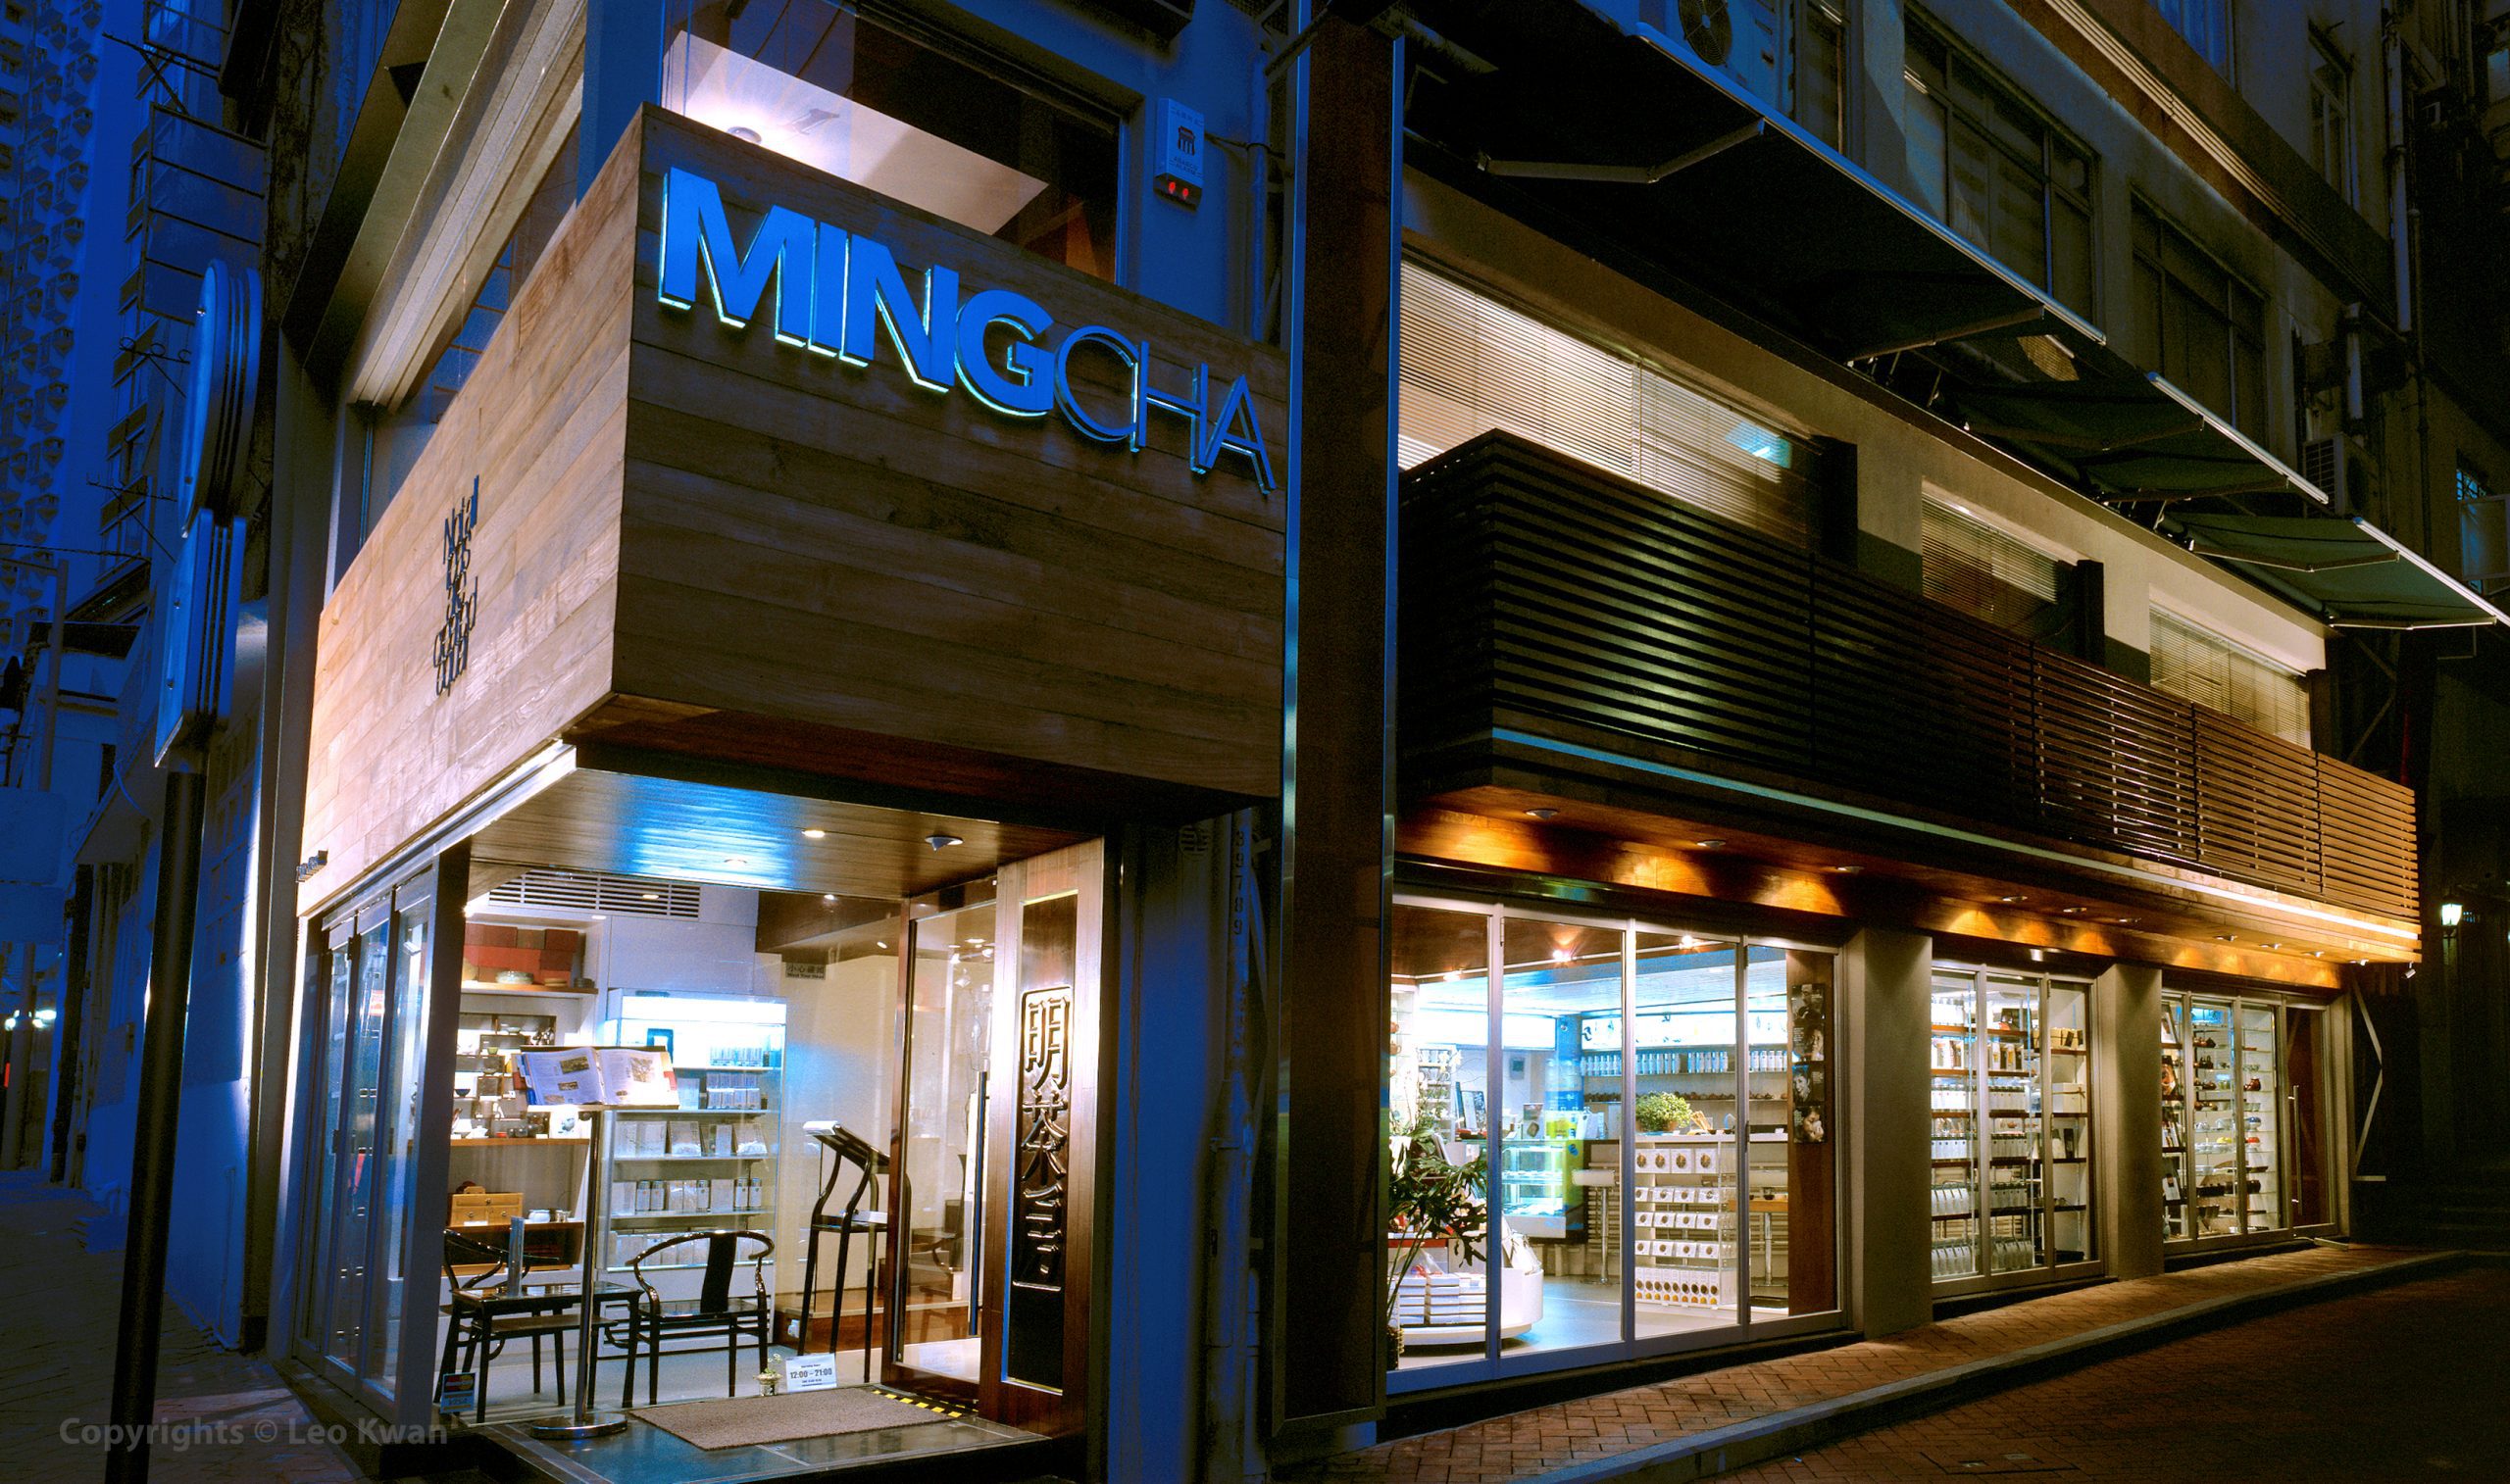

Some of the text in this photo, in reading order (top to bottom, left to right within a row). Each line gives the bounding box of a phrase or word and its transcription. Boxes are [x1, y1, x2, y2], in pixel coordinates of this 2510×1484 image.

[657, 166, 1276, 494] MINGCHA
[789, 1370, 808, 1379] 12:00
[814, 1367, 832, 1377] 21:00
